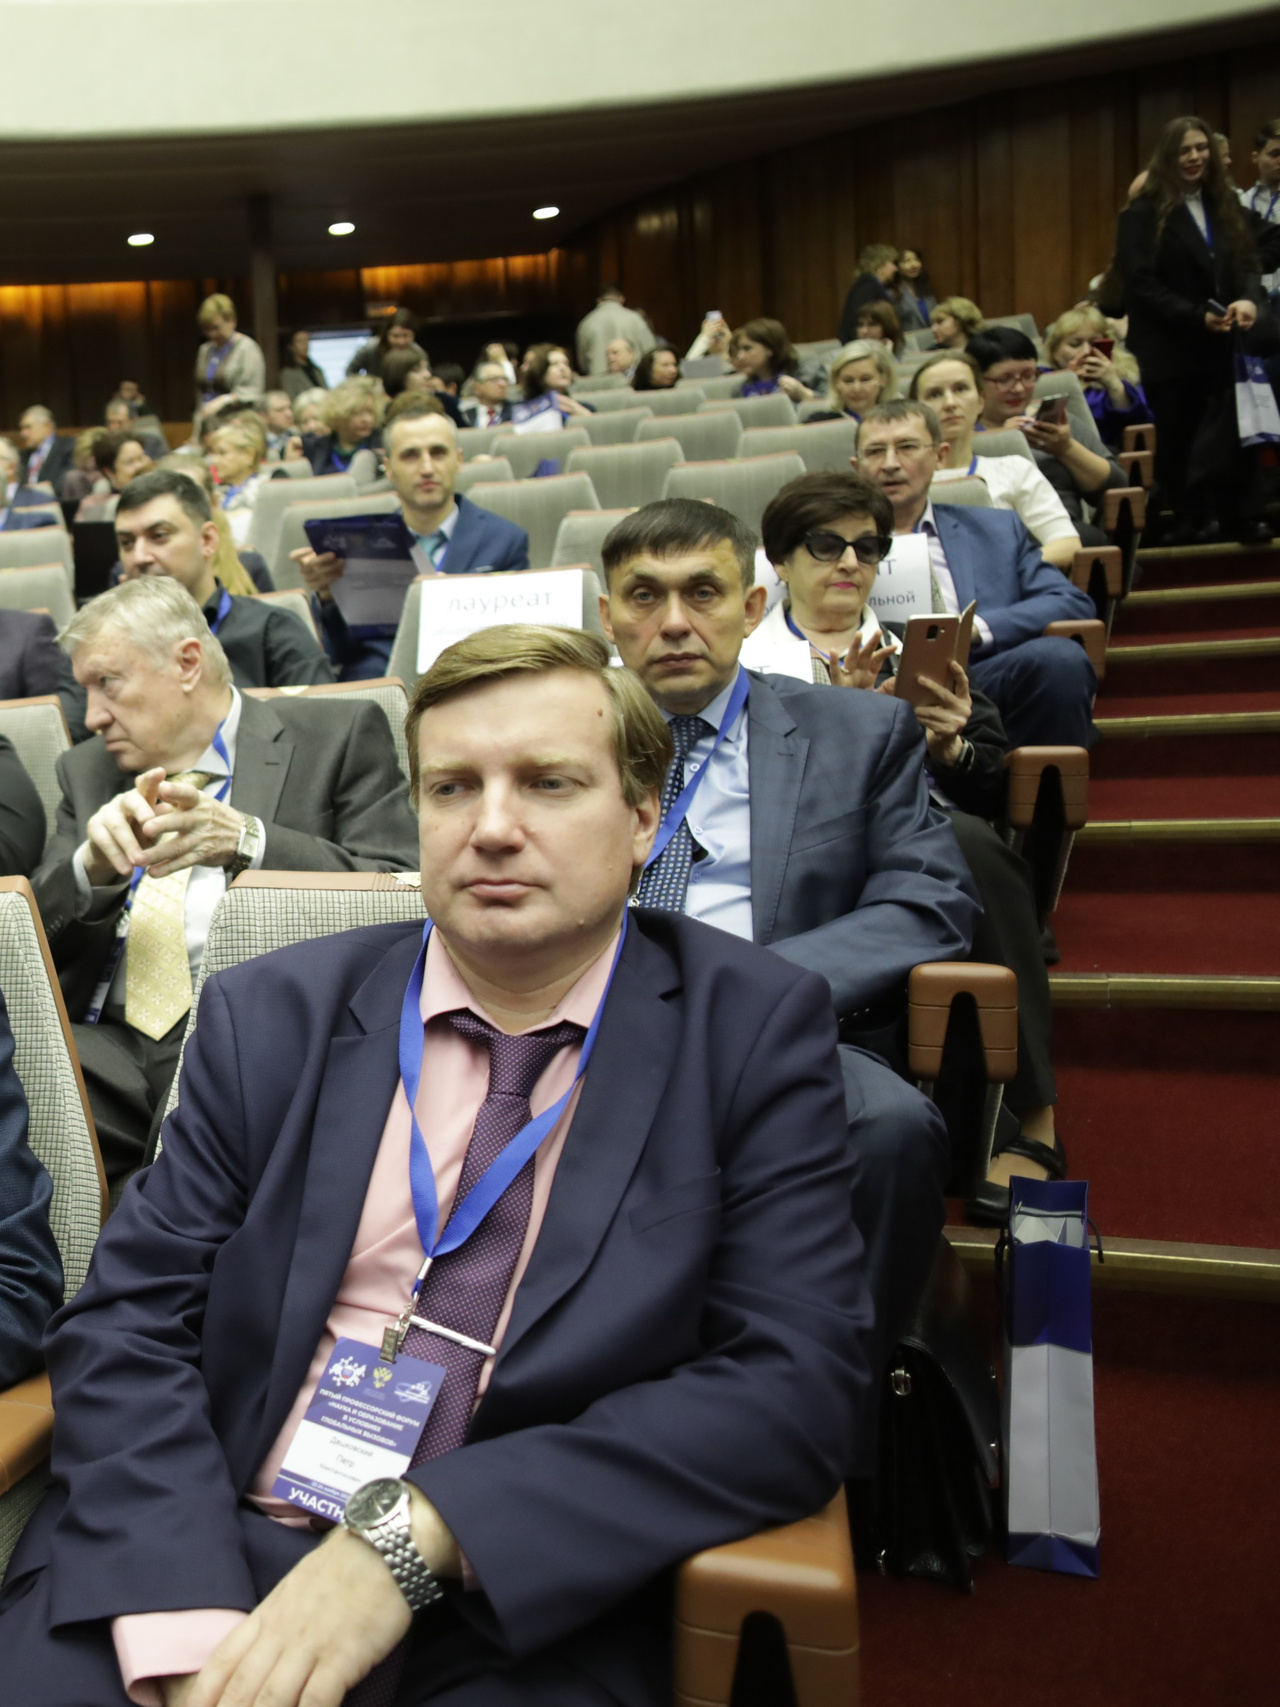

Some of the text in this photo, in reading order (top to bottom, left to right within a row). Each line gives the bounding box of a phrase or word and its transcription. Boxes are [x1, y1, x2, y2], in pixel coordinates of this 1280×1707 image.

[447, 592, 554, 615] лауреат
[341, 1396, 396, 1419] ПРОФЕССОРСКИЙ
[395, 1414, 420, 1427] ФОРУМ
[357, 1410, 404, 1432] ОБРАЗОВАНИЕ
[321, 1415, 363, 1435] ГЛОБАЛЬНЫХ
[348, 1416, 382, 1432] УСЛОВИЯХ
[329, 1436, 373, 1457] Дашковский
[336, 1454, 356, 1468] Петр
